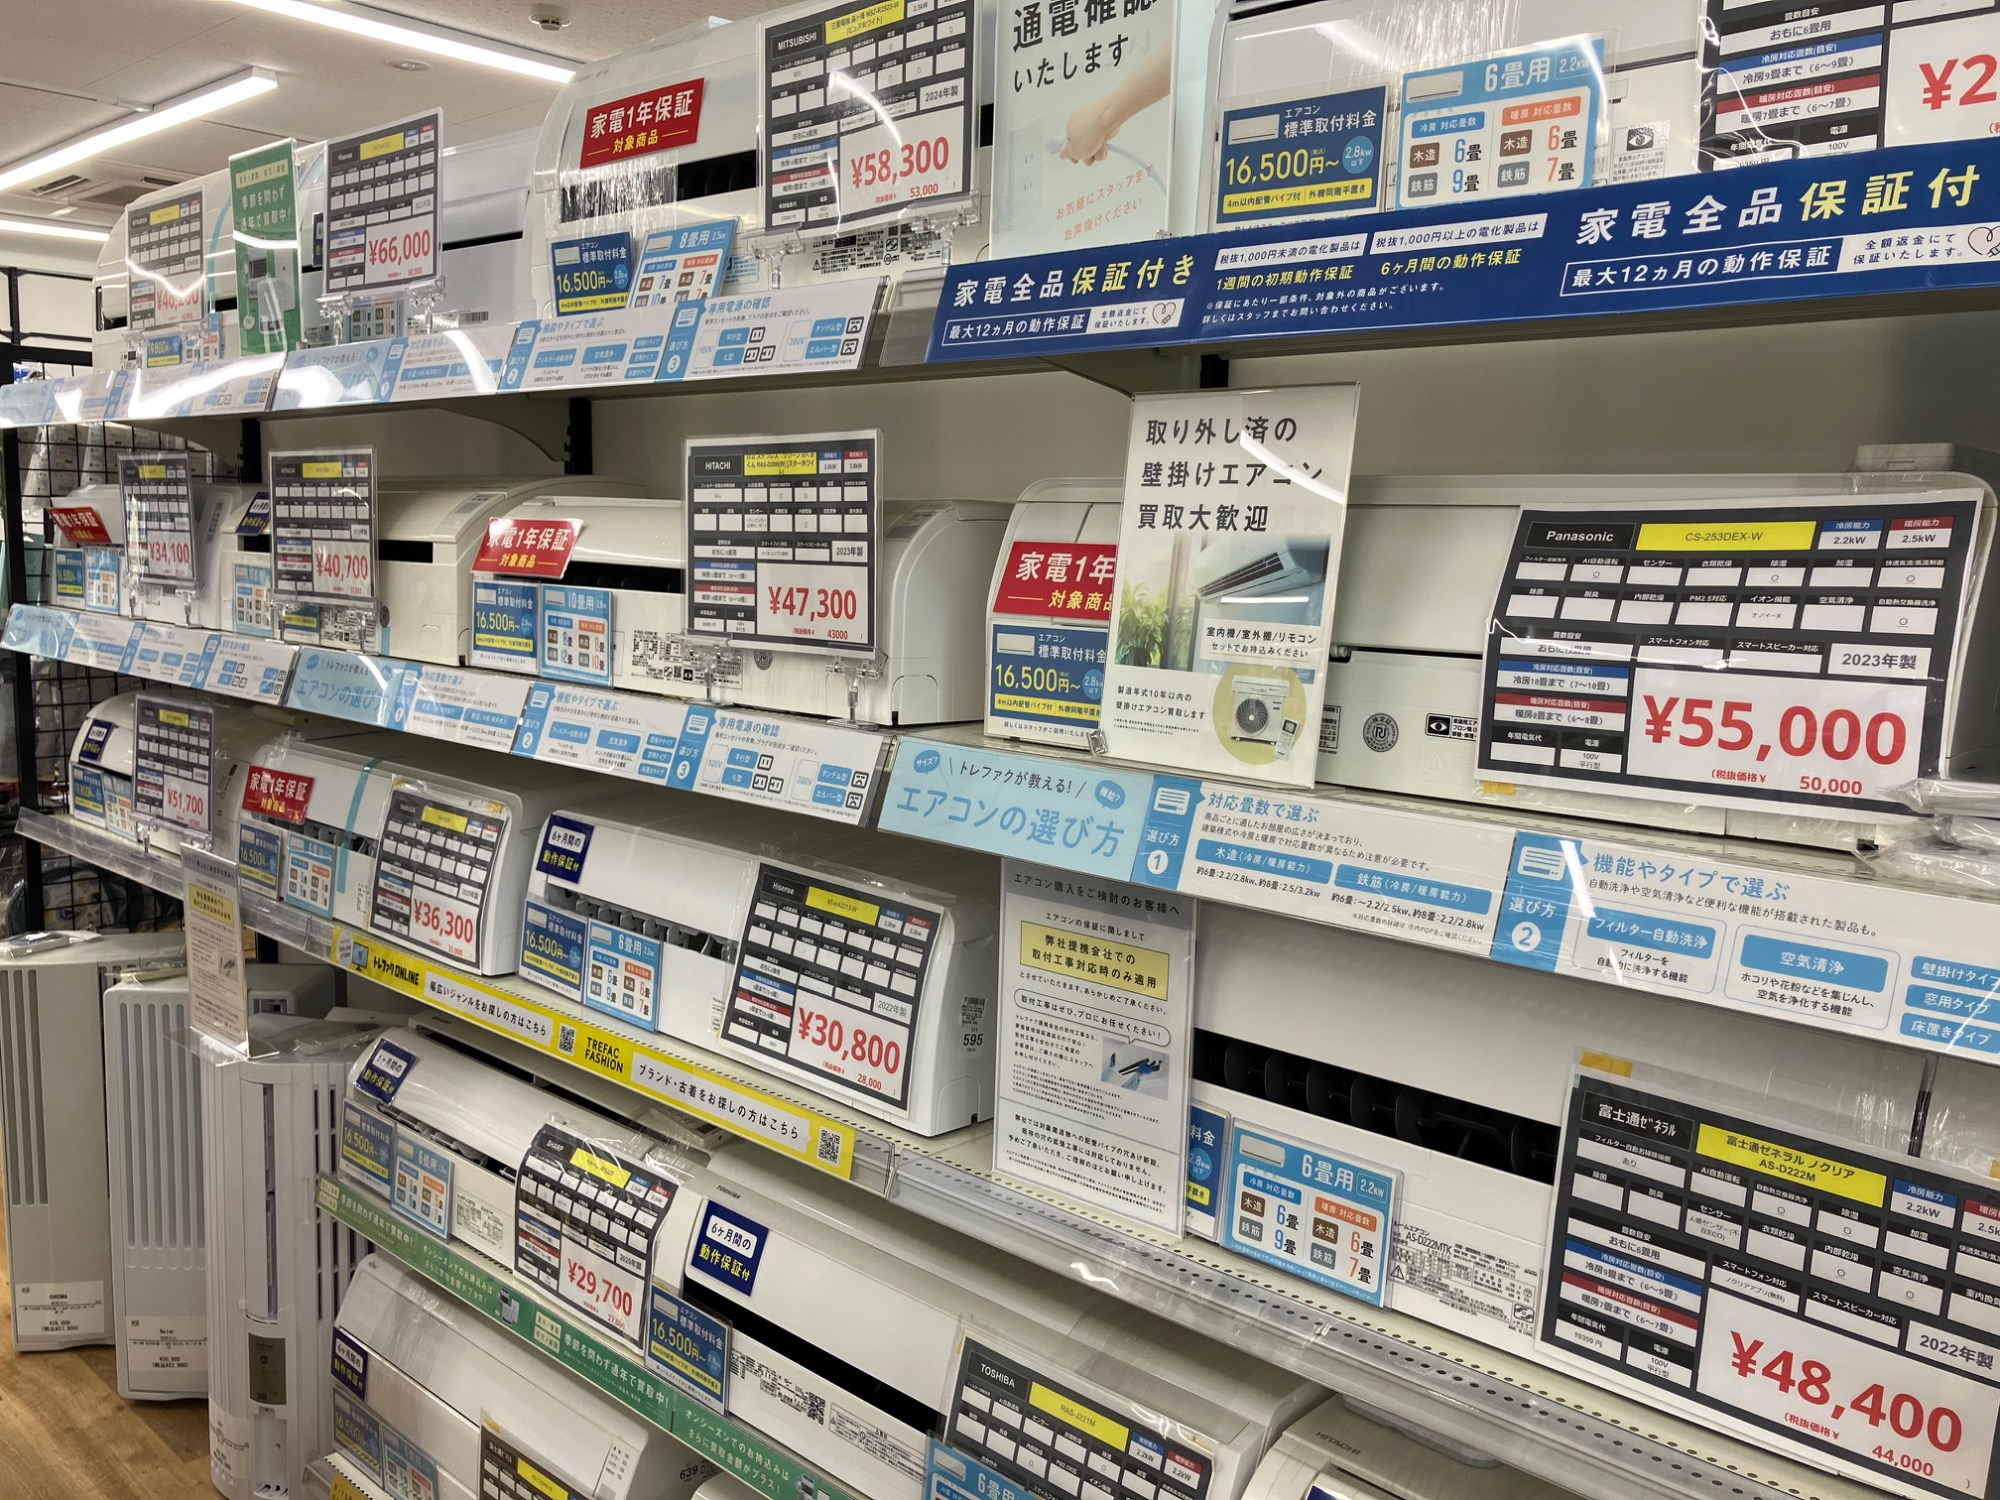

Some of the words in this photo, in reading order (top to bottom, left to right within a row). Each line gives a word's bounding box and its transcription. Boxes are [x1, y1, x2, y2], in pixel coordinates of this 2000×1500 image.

[778, 32, 817, 51] MITSUBISHI
[1771, 20, 1831, 39] おもに6畳用
[1014, 35, 1129, 93] いたします
[1484, 57, 1551, 92] 6畳用
[1918, 54, 1997, 111] ¥2
[590, 90, 695, 139] 家電1年保証
[1284, 105, 1321, 118] エアコン
[1284, 109, 1377, 139] 標準取付料金
[1510, 107, 1529, 120] 暖房
[1532, 102, 1573, 117] 対応畳数
[1420, 123, 1437, 134] 冷房
[1440, 116, 1477, 132] 対応畳数
[1503, 136, 1529, 150] 木造
[1548, 125, 1578, 150] 6畳
[613, 130, 658, 154] 対象商品
[1413, 149, 1437, 163] 木造
[1454, 139, 1482, 163] 6畳
[851, 136, 949, 189] ¥58,300
[1501, 167, 1526, 181] 鉄筋
[1547, 157, 1575, 182] 7畳
[1056, 165, 1154, 221] お気軽にスタッフまで
[1308, 183, 1367, 201] 外機同階平置き
[1411, 178, 1436, 193] 鉄筋
[1452, 169, 1480, 193] 9畳
[242, 185, 286, 210] 季節を問わず
[1226, 190, 1301, 210] 4m以内配管パイプ付
[1577, 187, 1783, 247] 家電全品
[1800, 165, 1980, 223] 保証付
[1064, 197, 1143, 241] お声掛けください
[368, 228, 430, 266] ¥66,000
[680, 231, 711, 250] 8畳用
[1375, 220, 1540, 249] 税抜1,000円以上の電化製品は
[1865, 232, 1955, 250] 全額返金にて
[1219, 238, 1361, 265] 税抜1,000円未満の電化製品は
[1853, 246, 1964, 266] 保証いたします。
[953, 269, 1065, 308] 家電全品
[1070, 254, 1195, 297] 保証付き
[1216, 265, 1353, 292] 1週間の初期動作保証
[708, 295, 772, 315] 専用電源の確認
[1202, 299, 1394, 325] 詳しくはスタッフまでお問い合わせください。
[1146, 416, 1297, 446] 取り外し済の
[1138, 504, 1269, 532] 買取大歓迎
[1836, 520, 1870, 532] 冷房能力
[1904, 517, 1940, 530] 暖房能力
[488, 528, 570, 552] 家電1年保証
[1546, 530, 1614, 546] Panasonic
[1685, 530, 1763, 544] CS-253DEX-W
[149, 540, 190, 565] ¥34,100
[500, 554, 536, 569] 対象商品
[1642, 559, 1674, 567] センサー
[315, 553, 369, 579] ¥40,700
[568, 592, 594, 612] 10畳用
[768, 585, 858, 623] ¥47,300
[1038, 634, 1066, 643] エアコン
[1206, 626, 1317, 645] 室内機/室外機/リモコン
[1648, 637, 1710, 648] スマートフォン対応
[1737, 642, 1820, 653] スマートスピーカー対応
[1038, 644, 1107, 664] 標準取付料金
[1211, 641, 1309, 659] セットでお持込みください
[1842, 653, 1917, 670] 2023年製
[557, 690, 619, 712] 機能やタイプで選ぶ
[1117, 684, 1193, 703] 製造年式10年以内の
[1116, 700, 1206, 722] 壁掛けエアコン買取します
[719, 716, 780, 738] 専用電源の確認
[1507, 732, 1542, 744] 年間電気代
[1643, 692, 1908, 768] ¥55,000
[678, 745, 701, 759] 選び方
[249, 771, 308, 802] 家電1年保証
[821, 767, 849, 782] タンデム型
[960, 761, 1073, 794] トレファクが教える!
[1799, 775, 1864, 796] 50,000
[167, 787, 203, 817] ¥51,700
[1207, 792, 1320, 824] 対応畳数で選ぶ
[896, 786, 1125, 858] エアコンの選び方
[1203, 812, 1364, 849] 商品ごとに適したお部屋の広さが決まっており、
[1146, 829, 1180, 847] 選び方
[1201, 823, 1430, 873] 建築様式や冷房と暖房で対応畳数が異なるため注意が必要です。
[543, 848, 580, 873] 動作保証付
[773, 880, 795, 896] Hisense
[1593, 853, 1790, 902] 機能やタイプで選ぶ
[1013, 873, 1181, 917] エアコン購入をご検討のお客様へ
[1588, 878, 1878, 937] 自動洗浄や空気清浄など便利な機能が搭載された製品も。
[413, 898, 474, 945] ¥36,300
[1045, 912, 1146, 943] エアコンの保証に関しまして
[1594, 917, 1709, 950] フィルター自動洗浄
[1044, 934, 1136, 966] 弊社提携会社での
[1620, 948, 1669, 966] フィルターを
[1779, 950, 1845, 976] 空気清浄
[394, 965, 419, 987] ONLINE
[1031, 948, 1157, 990] 取付工事対応時のみ適用
[1020, 970, 1168, 1016] とさせていただきます。あらかじめご了承ください。
[1740, 972, 1875, 1009] ホコリや花粉などを集じんし、
[1923, 992, 1991, 1015] 窓用タイプ
[429, 979, 548, 1037] 幅広いジャンルをお探しの方はこちら
[878, 999, 908, 1018] 2022年製
[1756, 990, 1854, 1018] 空気を浄化する機能
[585, 1036, 620, 1059] TREFAC
[797, 1006, 901, 1076] ¥30,800
[963, 1032, 984, 1047] 595
[584, 1048, 624, 1075] FASHION
[857, 1072, 882, 1091] 28,000
[638, 1062, 800, 1141] ブランド・古着をお探しの方はこちら
[1595, 1134, 1673, 1165] フィルター自動お掃除機能
[1725, 1133, 1804, 1166] 富士通ゼネラル
[1806, 1157, 1856, 1180] ノクリア
[1008, 1133, 1168, 1195] 予めご了承いただき、ご理解のほどお願い申し上げます。
[1301, 1154, 1354, 1193] 6畳用
[1700, 1166, 1741, 1186] AI自動運転
[1758, 1159, 1817, 1184] AS-D222M
[1907, 1184, 1944, 1204] 冷房能力
[1243, 1198, 1263, 1213] 木造
[1276, 1205, 1300, 1231] 6畳
[1699, 1205, 1731, 1222] センサー
[1905, 1202, 1941, 1220] 2.2kW
[1240, 1221, 1261, 1237] 鉄筋
[1274, 1230, 1297, 1256] 9畳
[1315, 1224, 1336, 1240] 木造
[1350, 1230, 1374, 1259] 6畳
[1405, 1231, 1453, 1256] AS-D222MTK
[1608, 1235, 1661, 1262] おもに6畳用
[698, 1243, 750, 1283] 動作保証付
[1312, 1249, 1334, 1266] 鉄筋
[1348, 1256, 1372, 1286] 7畳
[1600, 1252, 1665, 1283] 冷房対応畳数(目安)
[1722, 1260, 1788, 1289] スマートフォン対応
[568, 1258, 633, 1317] ¥29,700
[1812, 1290, 1898, 1326] スマートスピーカー対応
[1570, 1313, 1607, 1334] 年間電気代
[1920, 1334, 1994, 1371] 2022年製
[979, 1362, 1017, 1389] TOSHIBA
[1646, 1363, 1671, 1379] 平行型
[1729, 1329, 1964, 1454] ¥48,400
[1059, 1402, 1098, 1429] RAS-J221M
[685, 1408, 790, 1481] オンシーズンでのお持込みは
[1314, 1430, 1361, 1458] HITACHI
[679, 1465, 698, 1479] 639
[1871, 1444, 1935, 1479] 44,000
